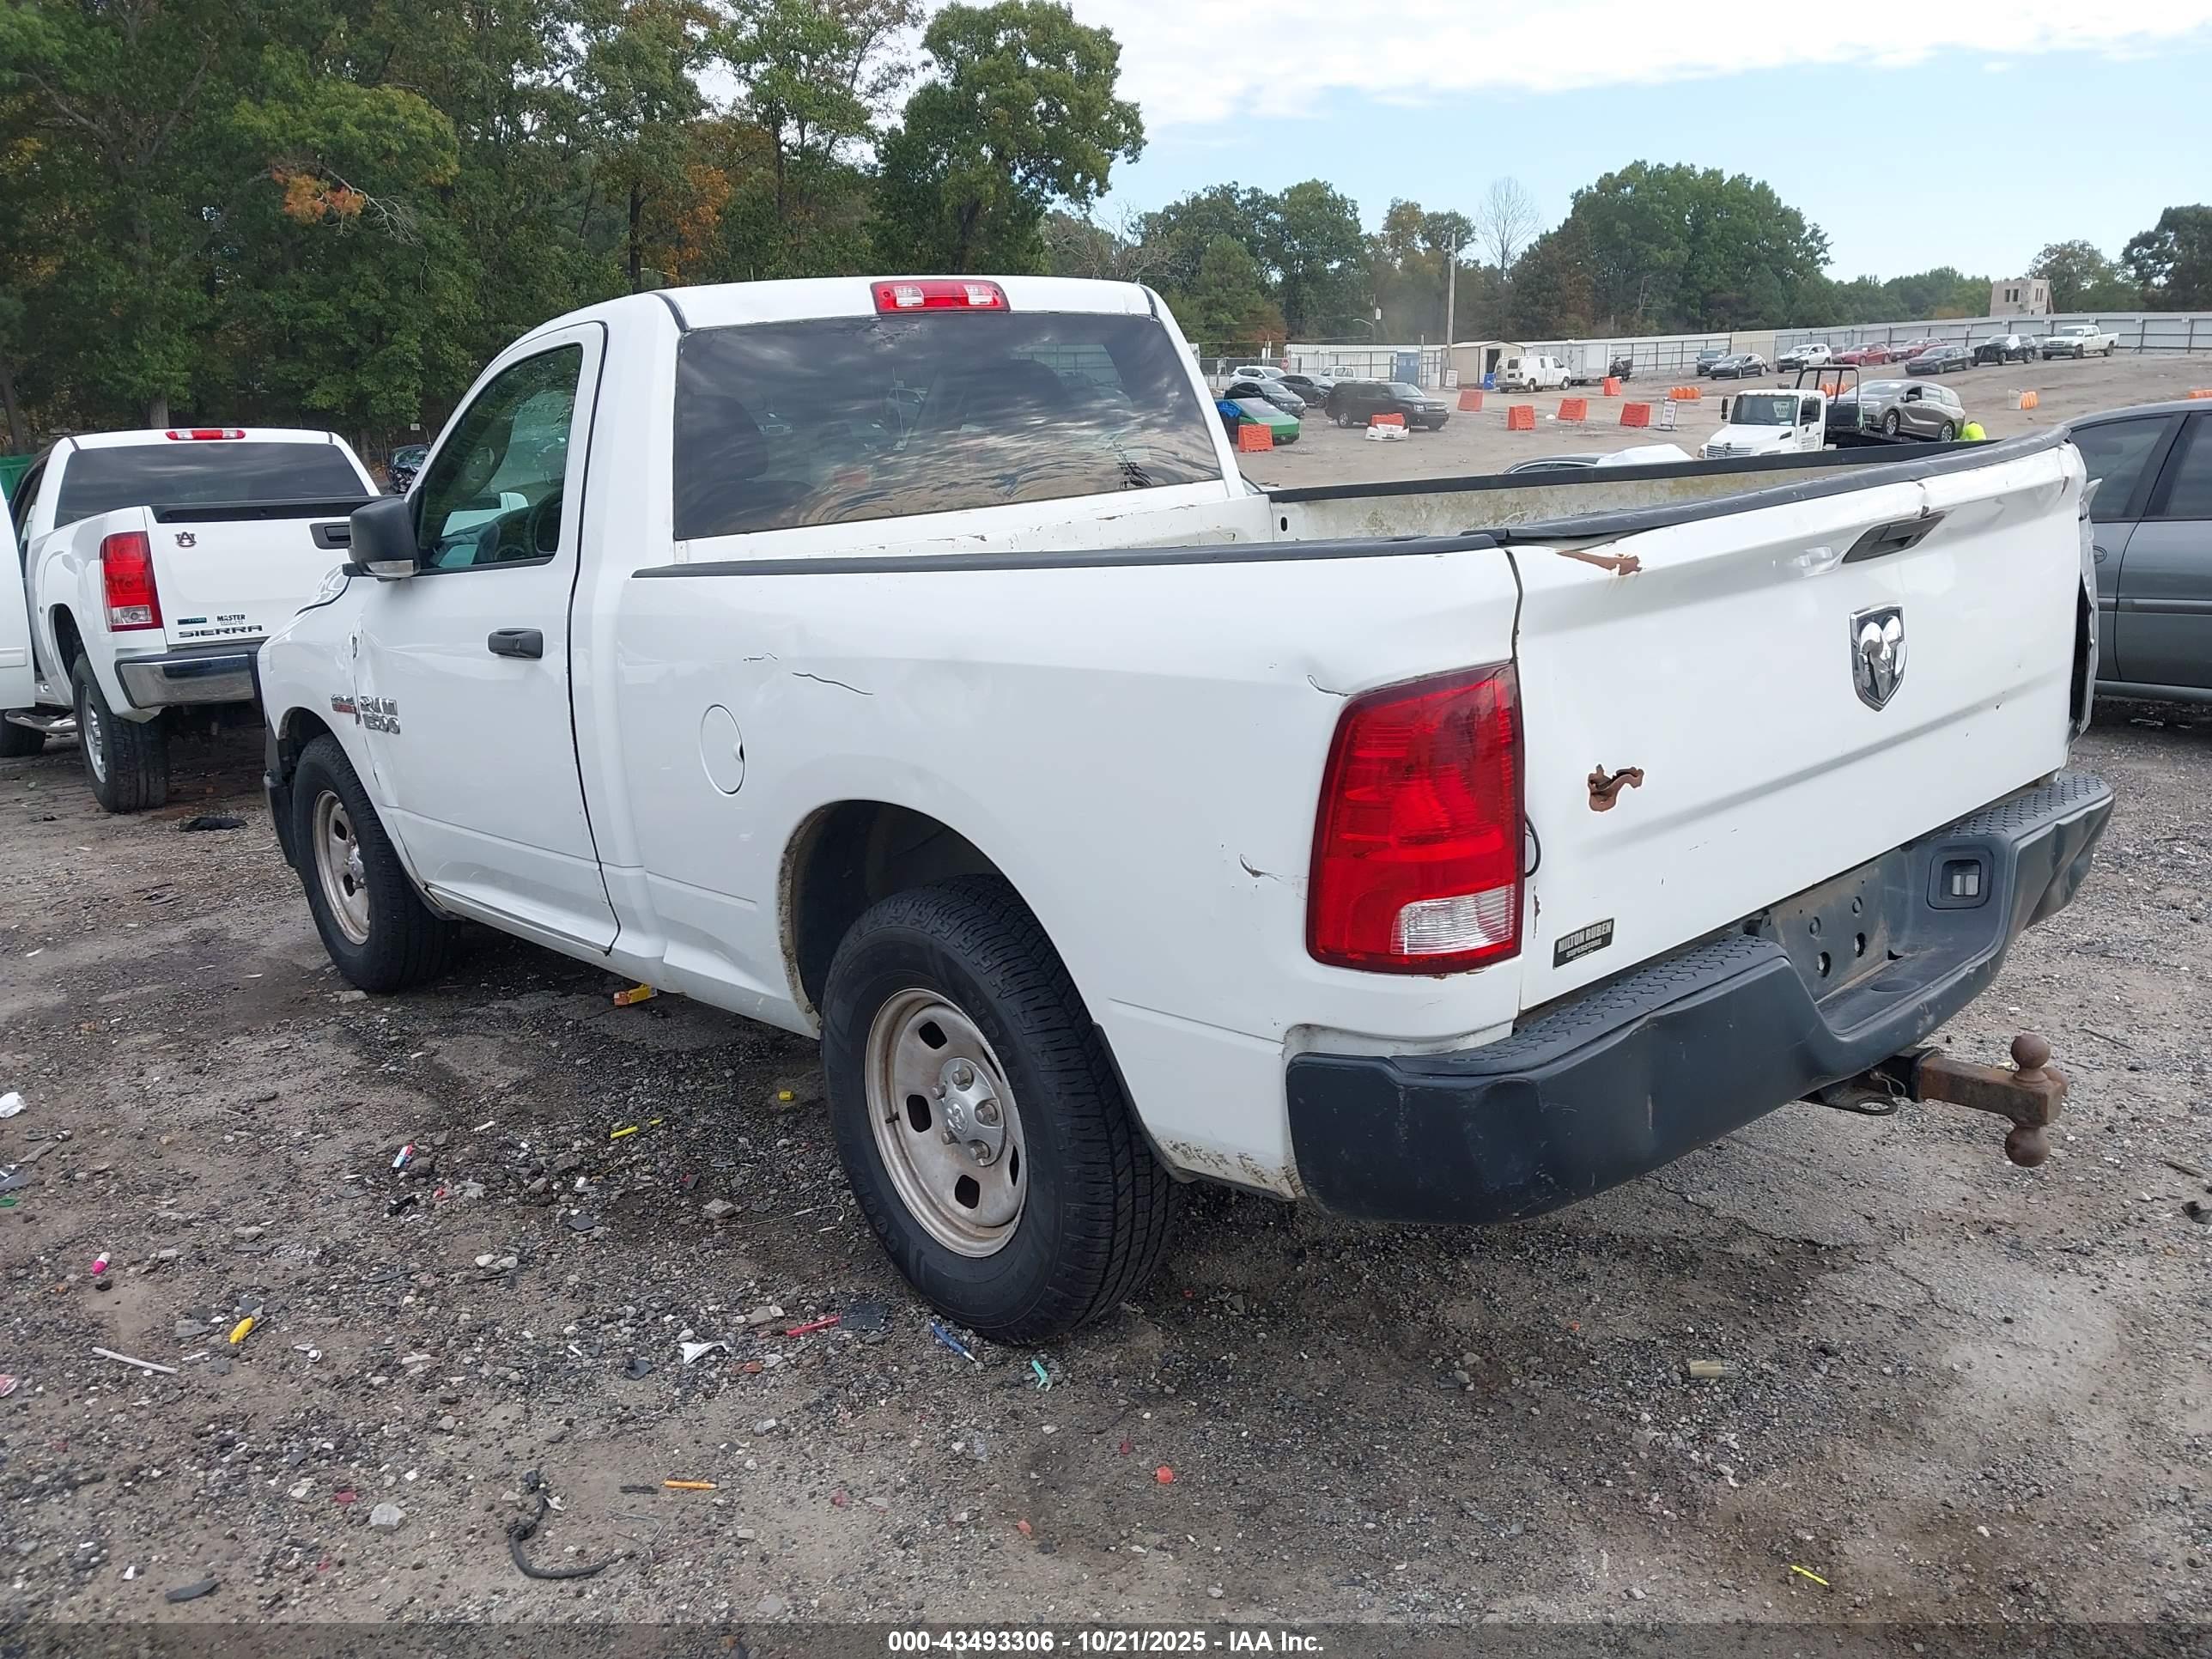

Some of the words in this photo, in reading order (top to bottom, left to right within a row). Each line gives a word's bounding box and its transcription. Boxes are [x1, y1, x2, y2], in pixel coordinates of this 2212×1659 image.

[179, 625, 262, 638] SIERRA
[359, 696, 398, 715] RAM
[1586, 920, 1612, 941] RUBEN
[1566, 938, 1602, 958] SUPERSTORE
